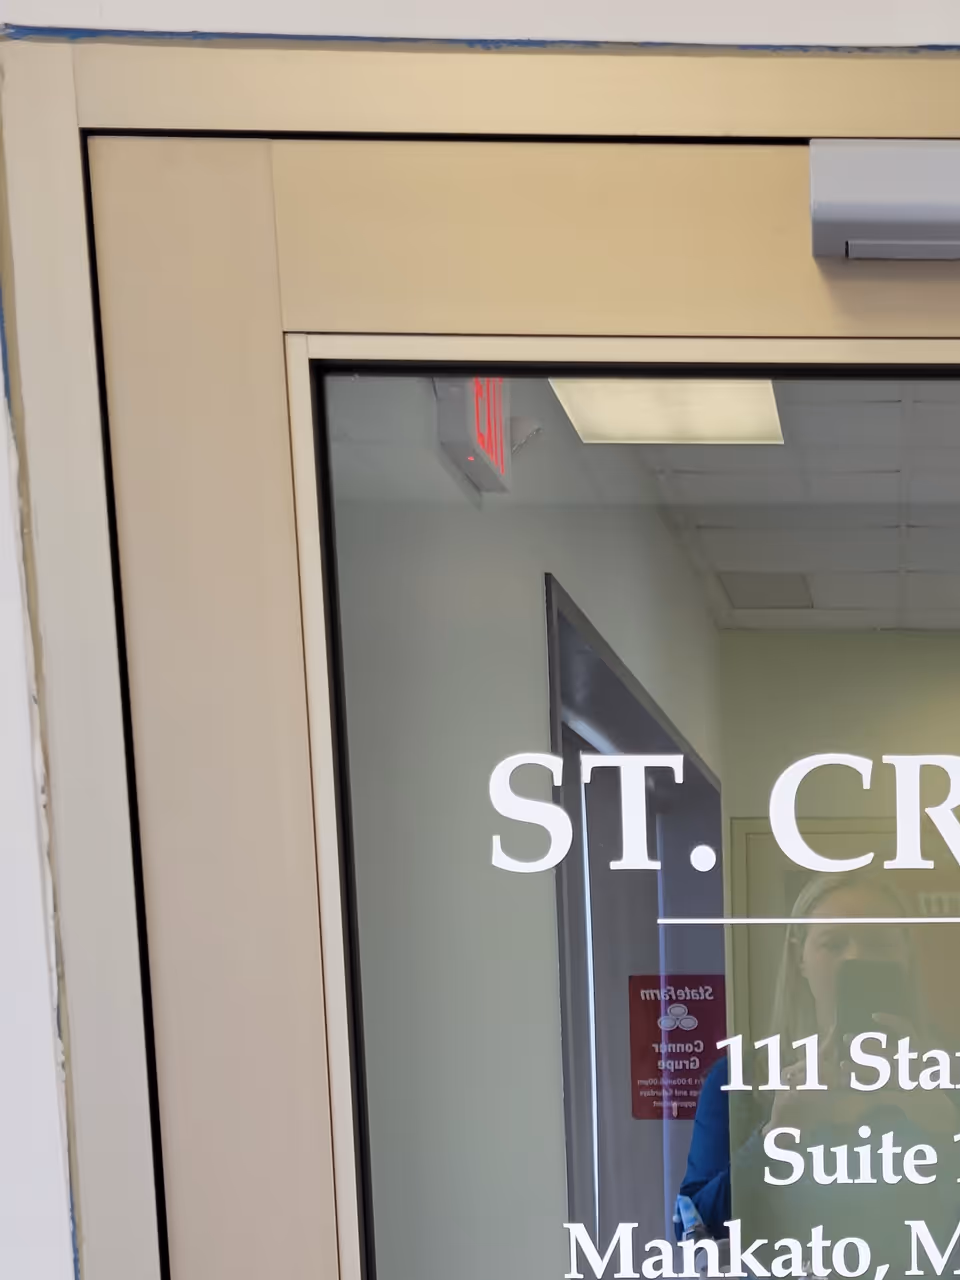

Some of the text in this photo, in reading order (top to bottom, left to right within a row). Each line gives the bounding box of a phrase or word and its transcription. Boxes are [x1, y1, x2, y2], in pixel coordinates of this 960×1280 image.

[489, 751, 717, 874] ST.
[717, 1032, 828, 1091] 111
[763, 1126, 938, 1186] Suite
